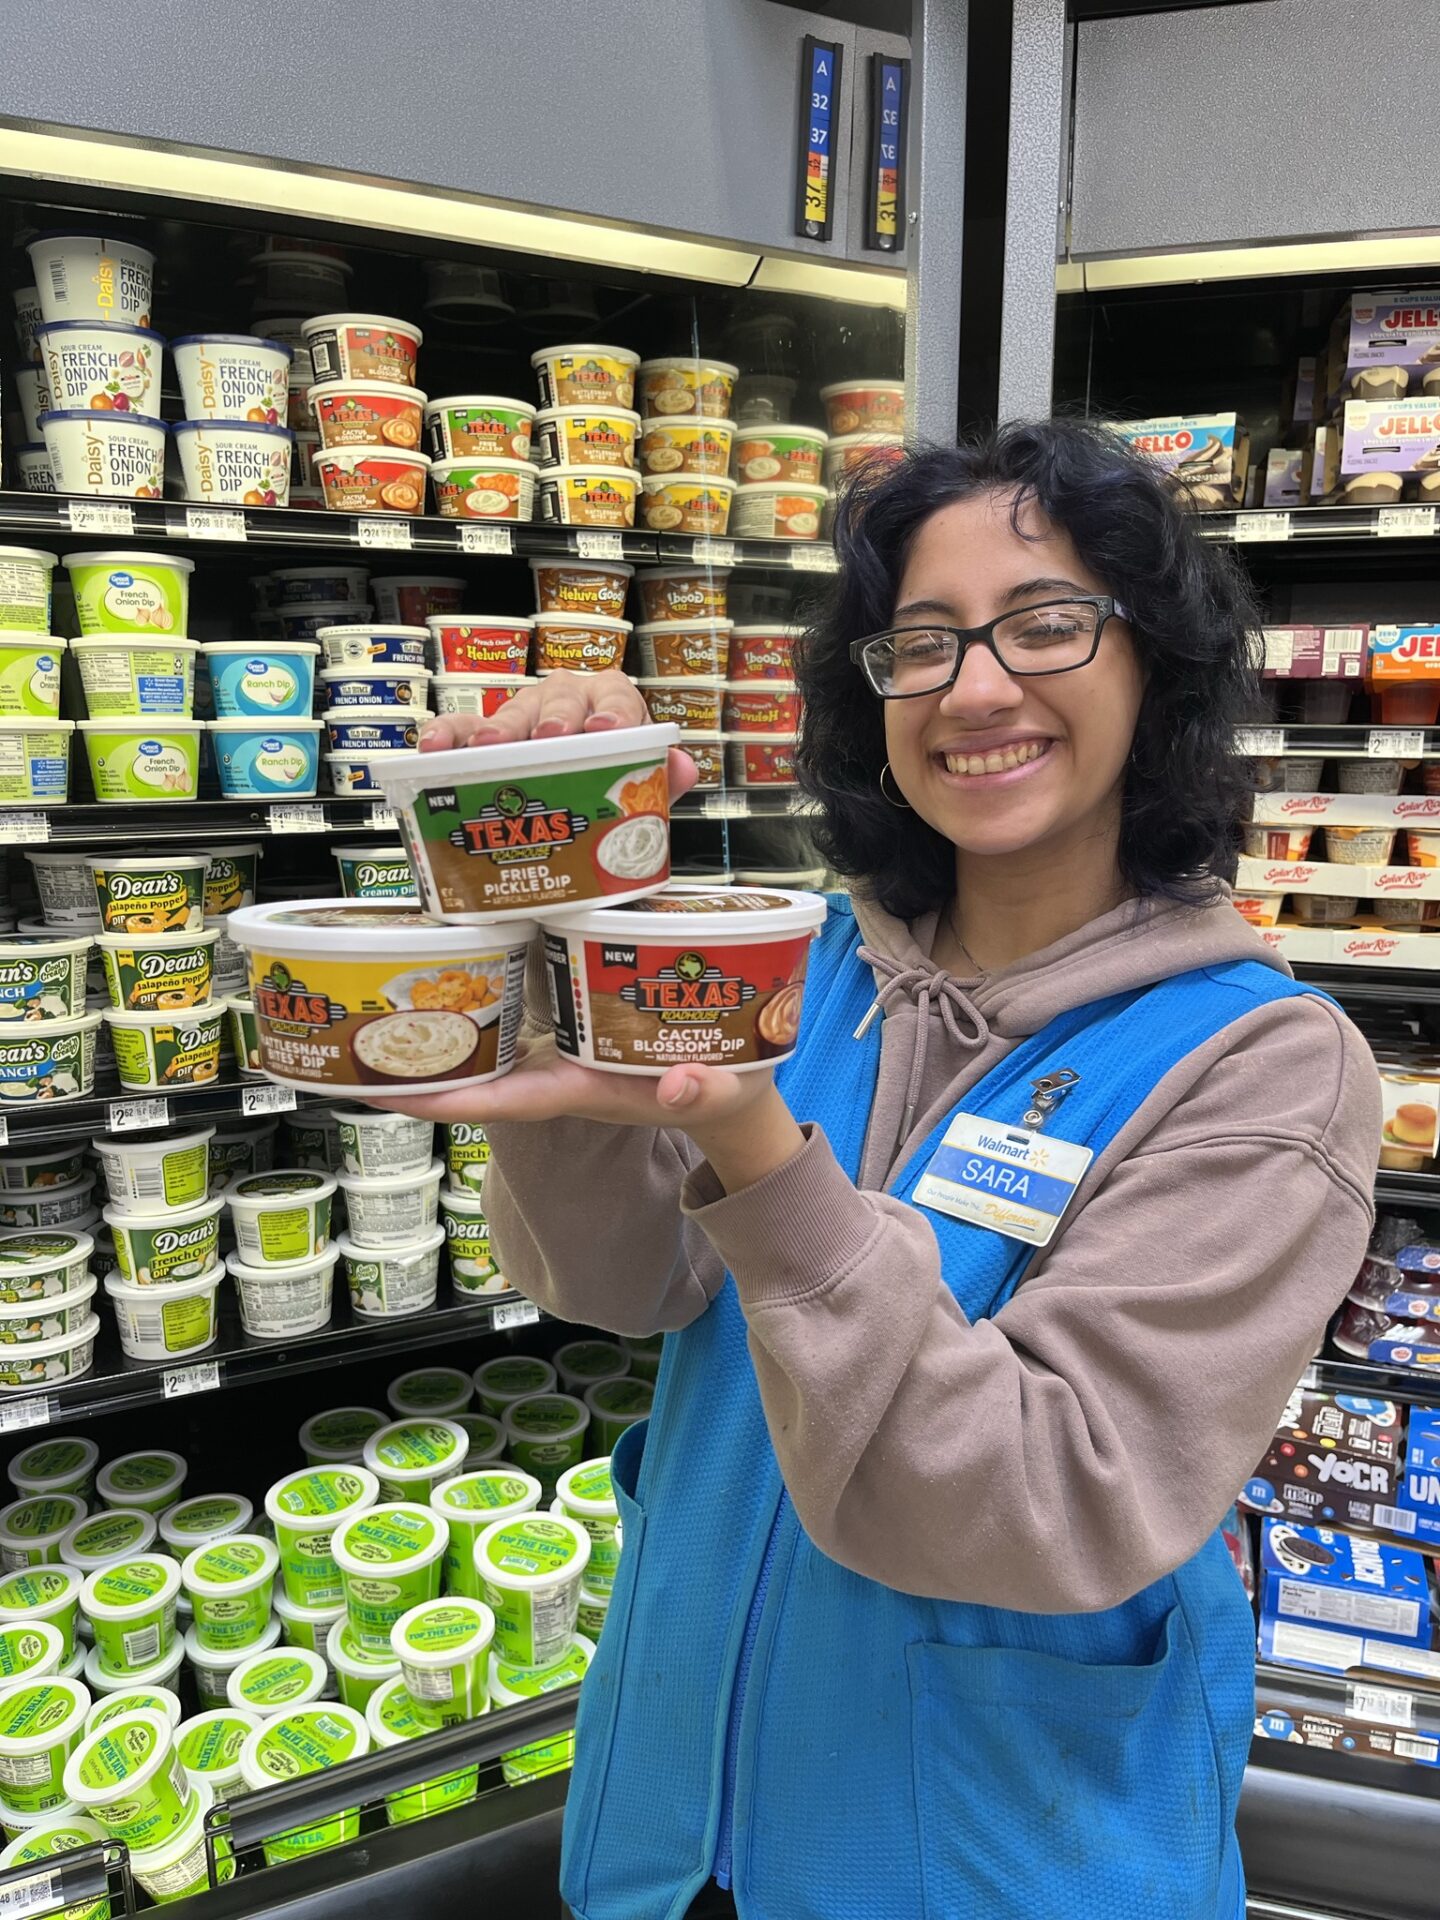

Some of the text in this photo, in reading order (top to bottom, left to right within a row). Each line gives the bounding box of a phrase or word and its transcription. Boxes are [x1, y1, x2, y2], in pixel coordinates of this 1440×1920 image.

[816, 60, 828, 76] A
[812, 93, 828, 110] 32
[811, 128, 827, 144] 37
[806, 181, 821, 208] 37
[97, 258, 115, 309] Daisy
[120, 296, 140, 312] DIP
[1385, 308, 1440, 329] JELL-
[62, 352, 118, 367] FRENCH
[219, 357, 261, 367] SOUR CREAM
[48, 348, 62, 399] Daisy
[64, 368, 109, 382] ONION
[220, 366, 272, 384] FRENCH
[66, 383, 88, 397] DIP
[202, 358, 216, 409] Daisy
[221, 381, 265, 397] ONION
[222, 395, 246, 408] DIP
[335, 409, 374, 422] TEXAS
[468, 422, 506, 435] TEXAS
[108, 435, 149, 446] SOUR CREAM
[586, 432, 620, 443] TEXAS
[1134, 431, 1193, 453] ELL-O
[109, 443, 157, 463] FRENCH
[235, 443, 258, 451] CREAM
[87, 433, 104, 486] Daisy
[110, 458, 151, 475] ONION
[215, 451, 270, 467] FRENCH
[201, 443, 214, 493] Daisy
[218, 464, 262, 478] ONION
[111, 472, 134, 486] DIP
[219, 478, 242, 492] DIP
[335, 476, 372, 489] TEXAS
[588, 490, 621, 503] TEXAS
[120, 590, 148, 598] French
[559, 585, 625, 601] Heluva Good!
[115, 598, 155, 607] Onion Dip
[473, 637, 493, 645] French
[392, 654, 416, 662] FRENCH
[466, 646, 507, 662] Heluva
[546, 643, 617, 659] Heluva Good!
[277, 680, 291, 689] Dip
[335, 696, 382, 705] FRENCH ONION
[368, 740, 391, 748] ONION
[169, 765, 180, 773] Dip
[262, 758, 303, 767] Ranch Dip
[429, 794, 455, 808] NEW
[1310, 796, 1335, 809] Rico
[465, 813, 571, 850] TEXAS
[358, 864, 414, 887] Dean
[501, 865, 549, 881] FRIED
[1292, 866, 1318, 878] Rico
[1404, 871, 1431, 884] Rico
[111, 874, 179, 899] Dean's
[207, 880, 238, 893] Popper
[360, 887, 399, 898] Creamy
[484, 875, 571, 896] PICKLE DIP
[109, 895, 184, 912] Jalapeño Popper
[112, 915, 126, 925] DIP
[1373, 939, 1400, 951] Rico
[142, 950, 206, 978] Dean's
[604, 950, 636, 963] NEW
[138, 969, 208, 991] Jalapeño Popper
[140, 993, 157, 1004] DIP
[641, 981, 740, 1008] TEXAS
[257, 986, 328, 1024] TEXAS
[661, 1010, 720, 1021] ROADHOUSE
[658, 1028, 723, 1040] CACTUS
[633, 1038, 745, 1053] BLOSSOM DIP
[176, 1050, 212, 1066] Jalapeño
[268, 1048, 326, 1068] BITES DIP
[656, 1052, 723, 1061] NATURALLY FLAVORED
[177, 1065, 193, 1077] DIP
[977, 1133, 1030, 1161] Walmart
[962, 1159, 1030, 1198] SARA
[984, 1202, 1040, 1228] Difference
[157, 1220, 215, 1254] Dean's
[152, 1252, 190, 1269] French
[153, 1268, 169, 1279] DIP
[1252, 1485, 1266, 1498] m
[1410, 1474, 1440, 1505] UN
[499, 1535, 569, 1557] TOP THE TATER
[410, 1624, 477, 1640] TOP THE TATER
[1269, 1719, 1284, 1732] m
